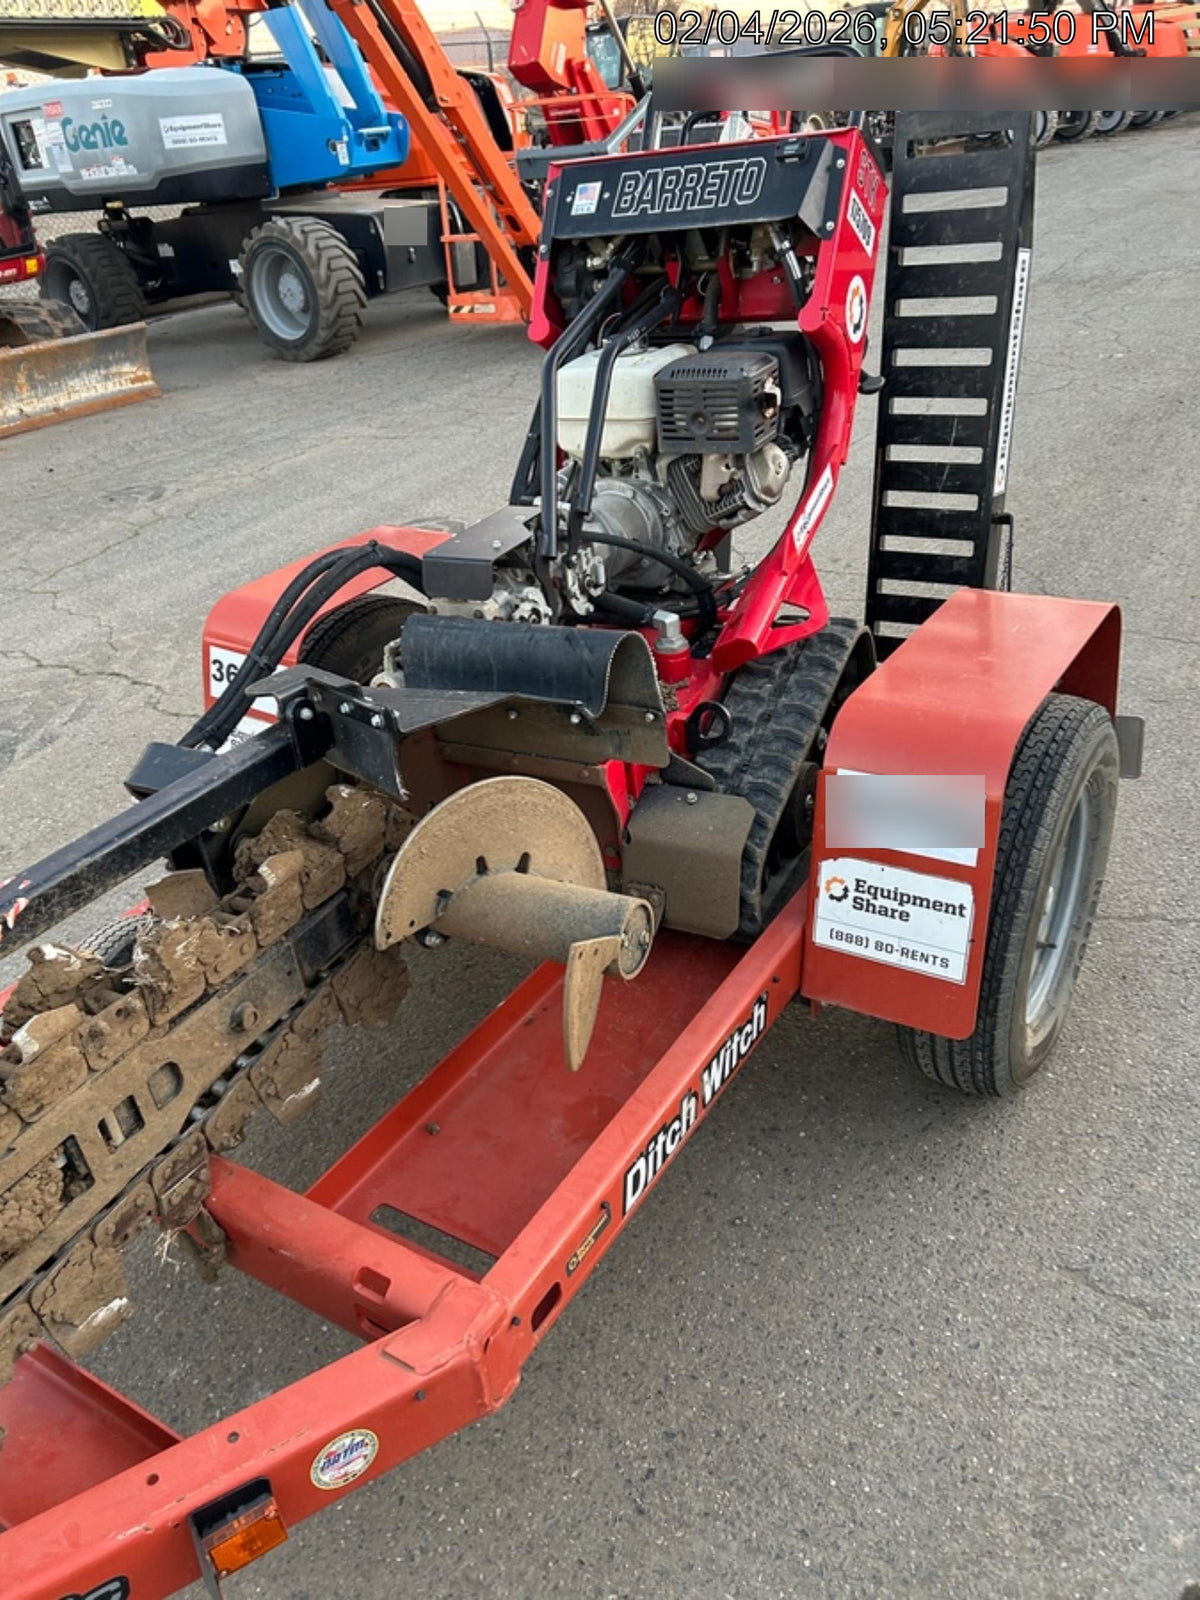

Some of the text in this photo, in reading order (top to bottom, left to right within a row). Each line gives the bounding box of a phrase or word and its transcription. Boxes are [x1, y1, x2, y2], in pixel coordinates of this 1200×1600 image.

[61, 113, 128, 153] Genie
[611, 156, 767, 218] BARRETO
[852, 896, 911, 923] Share
[853, 877, 967, 919] Equipment
[829, 926, 950, 970] (888) 80-RENTS
[623, 999, 768, 1216] Ditch Witch
